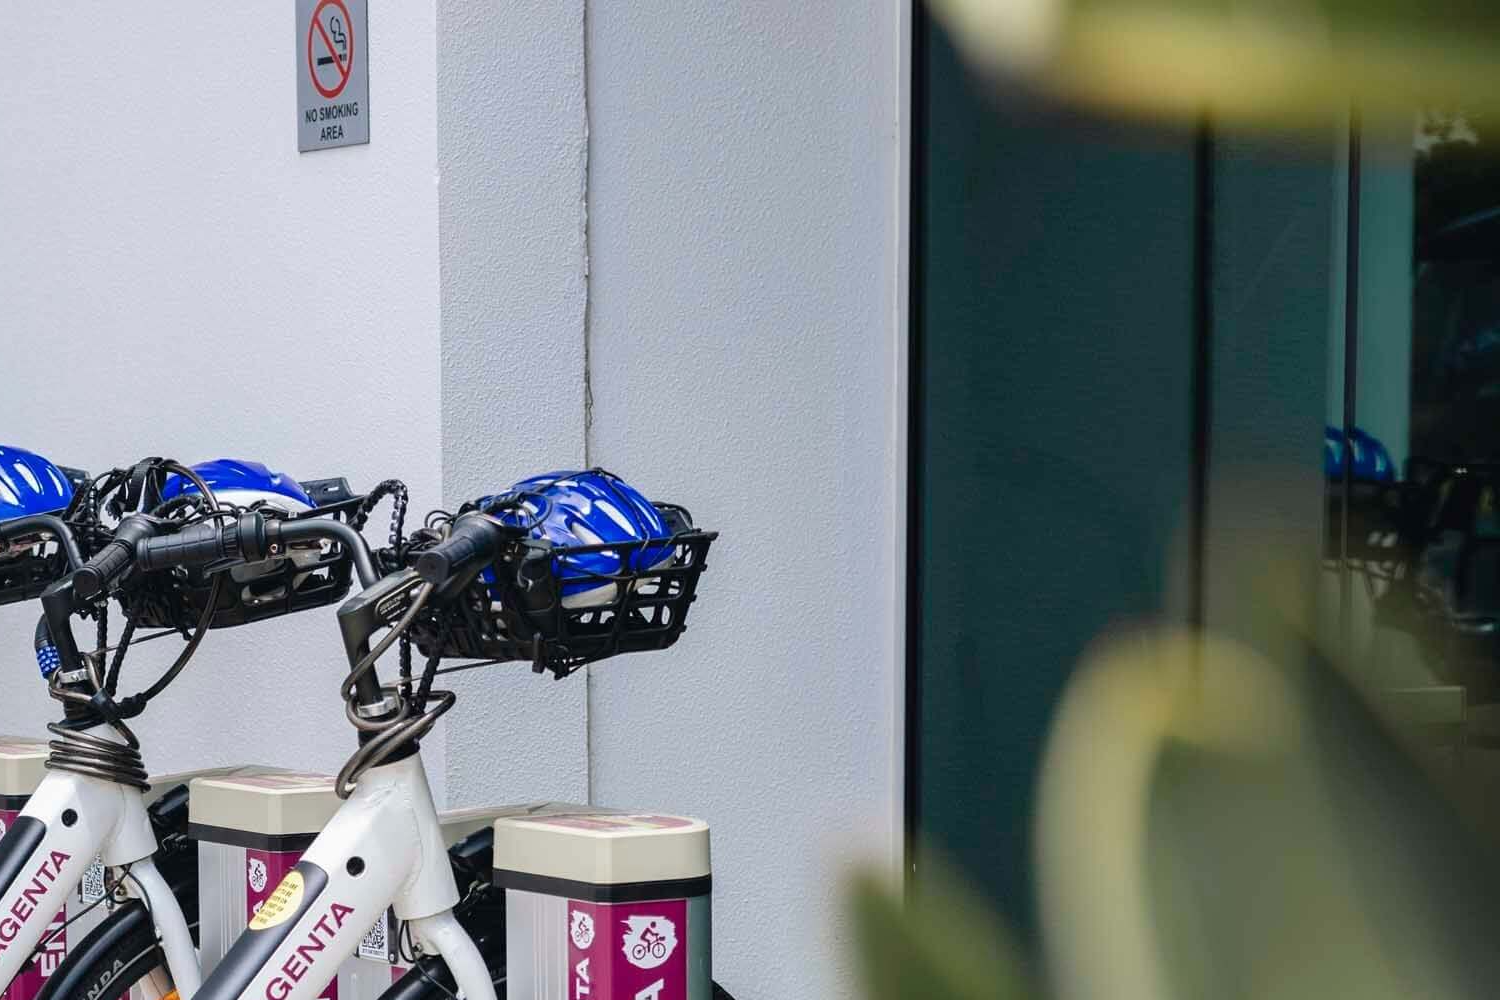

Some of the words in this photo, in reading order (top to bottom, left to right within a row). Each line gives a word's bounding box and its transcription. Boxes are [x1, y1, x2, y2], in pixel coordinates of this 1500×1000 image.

[305, 109, 317, 122] NO
[319, 102, 358, 121] SMOKING
[320, 125, 344, 141] AREA
